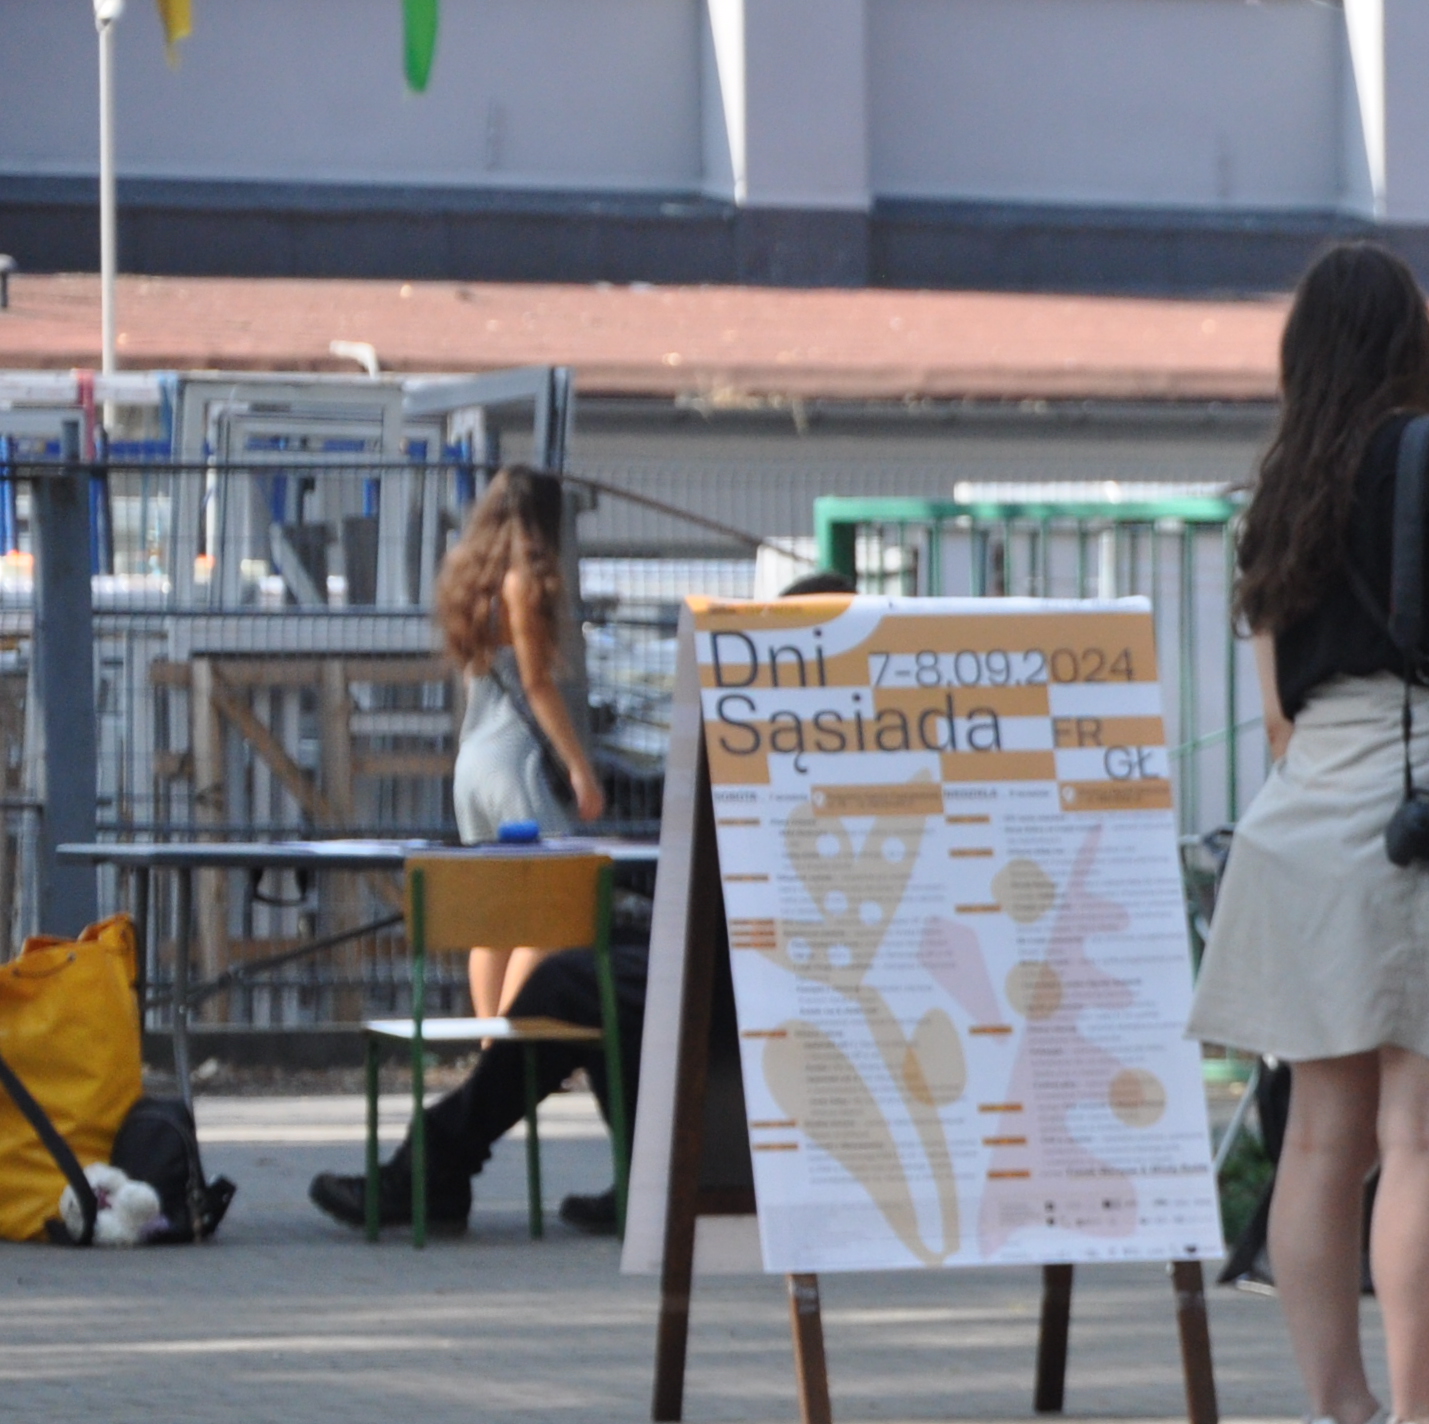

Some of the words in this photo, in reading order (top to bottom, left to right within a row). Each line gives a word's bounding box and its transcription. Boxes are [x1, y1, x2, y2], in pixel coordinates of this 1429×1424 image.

[710, 628, 827, 688] Dni
[873, 647, 1136, 688] 7-8.09.2024
[715, 692, 1002, 773] Sąsiada
[1051, 716, 1102, 749] FR
[1104, 744, 1160, 781] GŁ
